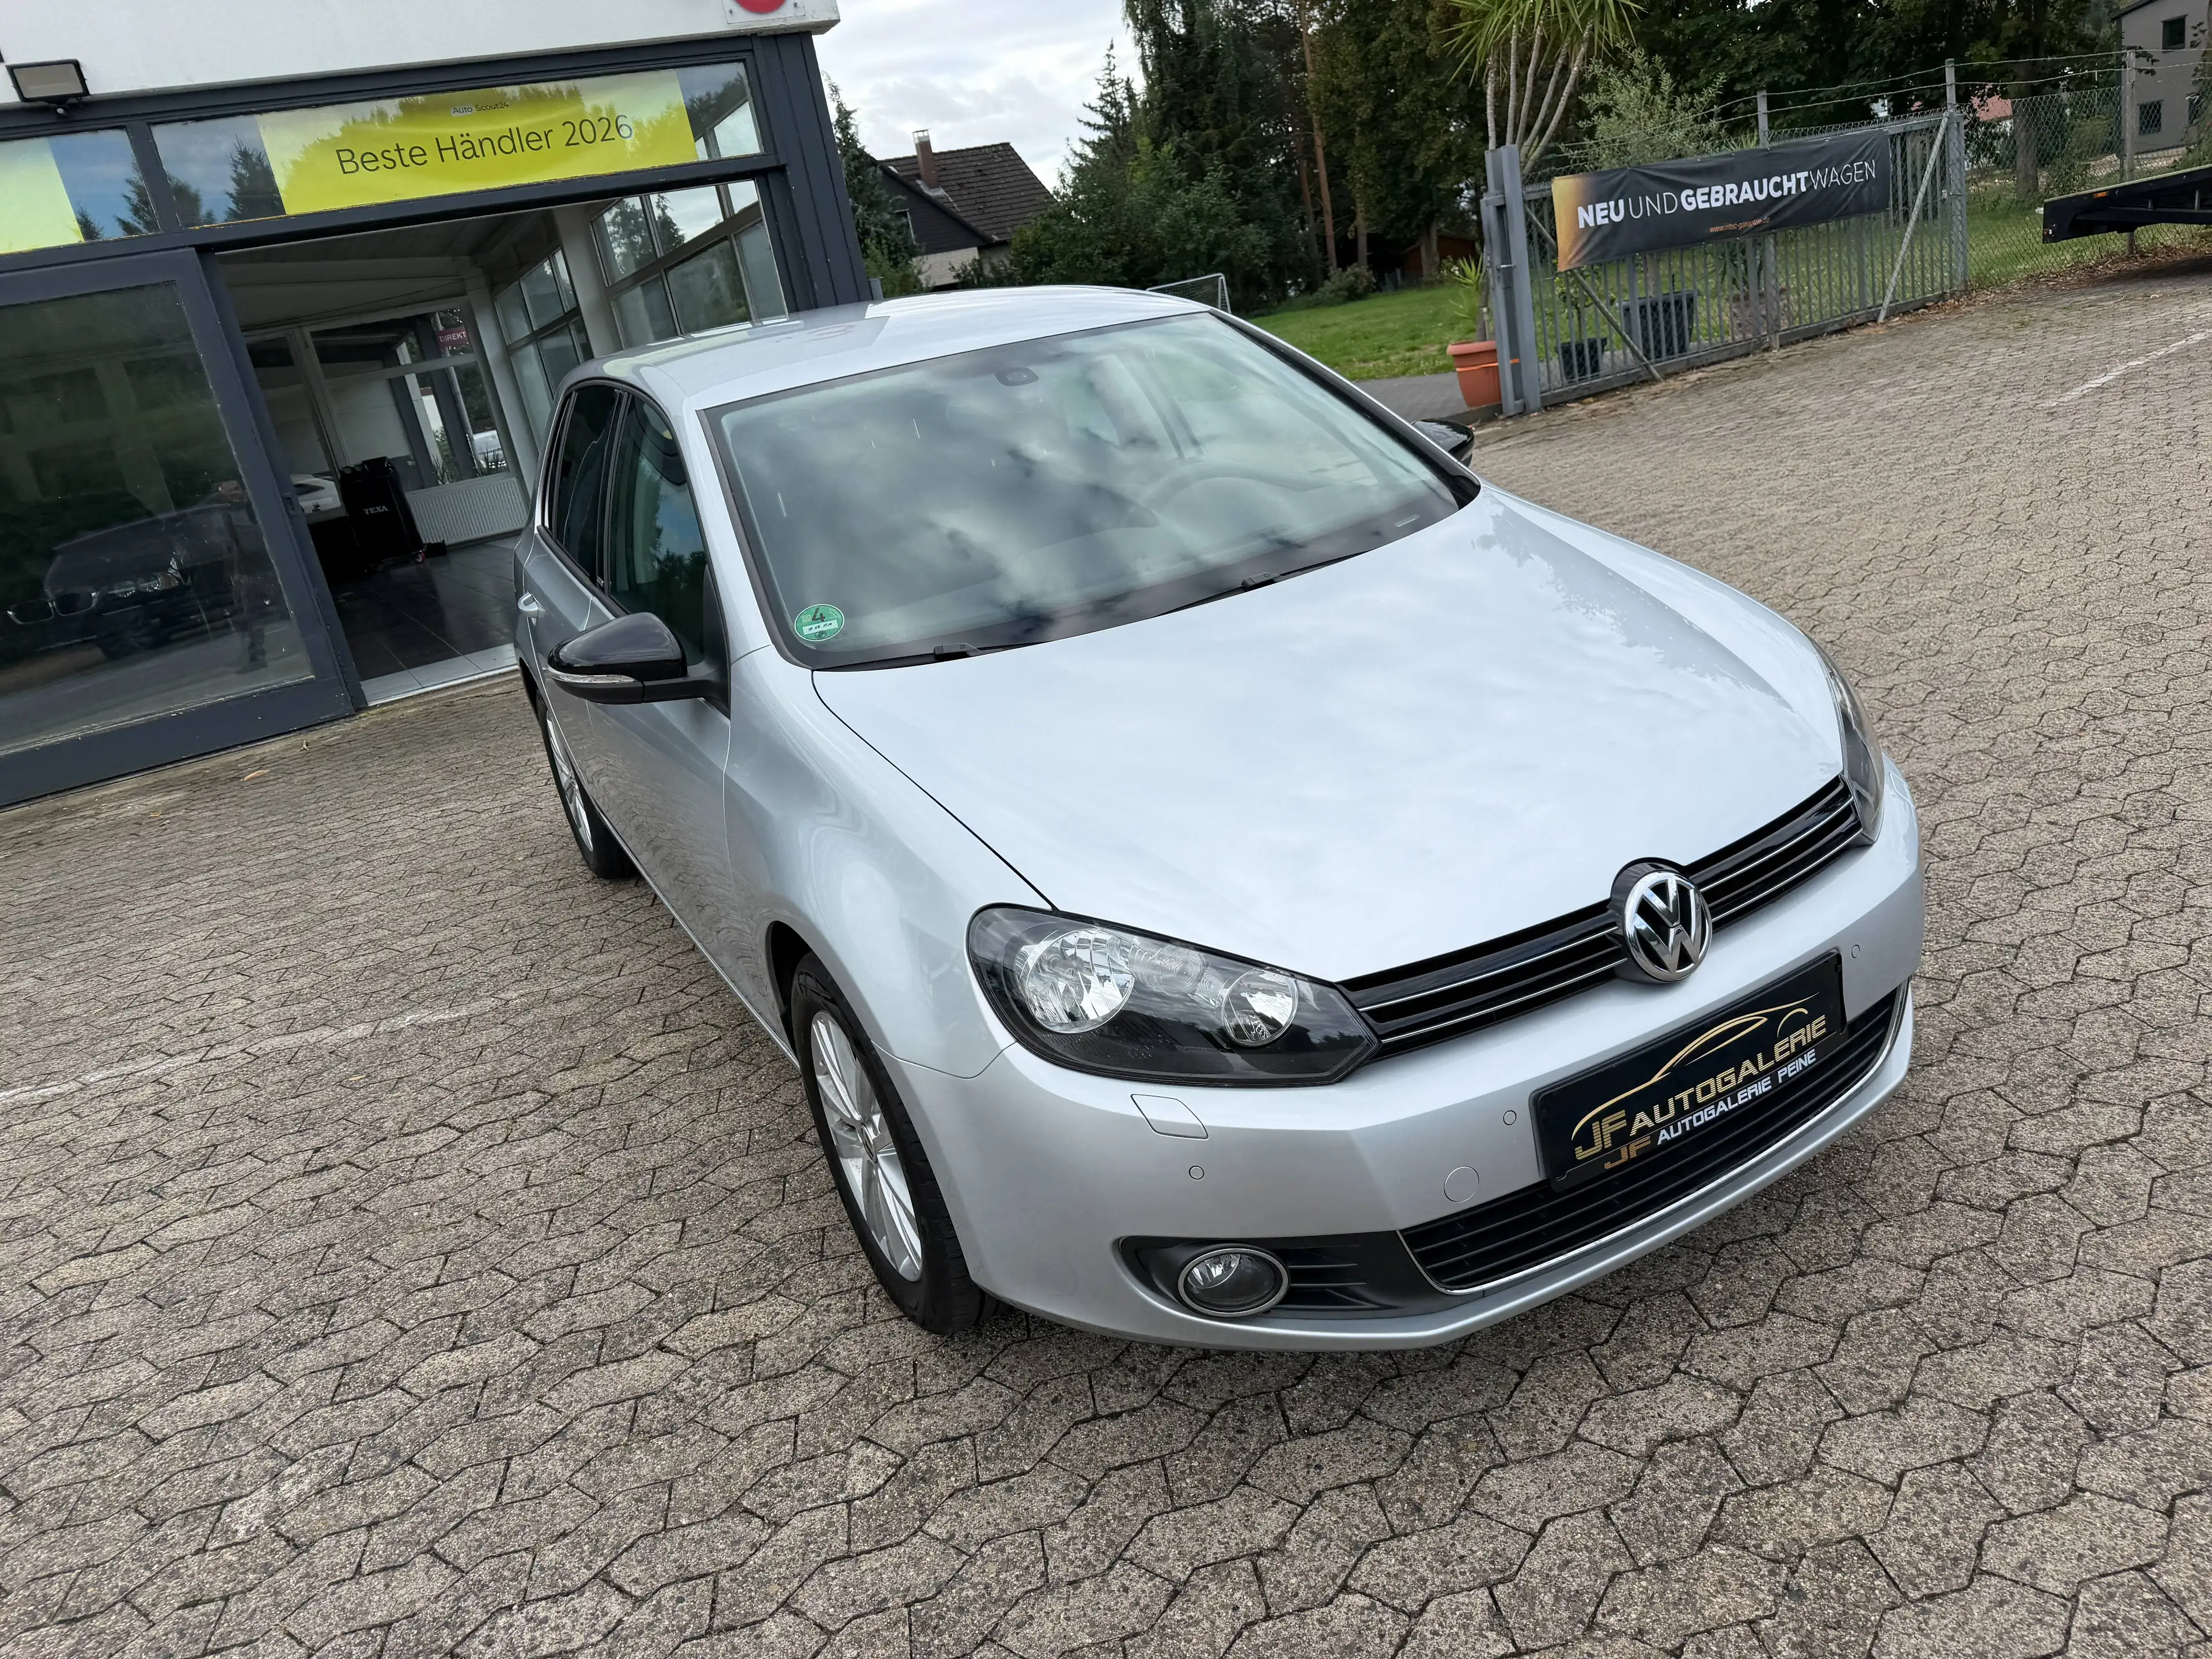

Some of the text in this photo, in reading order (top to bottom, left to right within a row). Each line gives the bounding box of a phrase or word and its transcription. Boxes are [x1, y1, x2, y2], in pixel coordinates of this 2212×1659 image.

[335, 115, 632, 175] Beste Händler 2026
[439, 331, 467, 342] DIREKT
[363, 506, 389, 514] TEXA
[812, 607, 825, 622] 4
[1574, 1014, 1827, 1160] JF AUTOGALERIE
[1604, 1048, 1816, 1169] JF AUTOGALERIE PEINE
